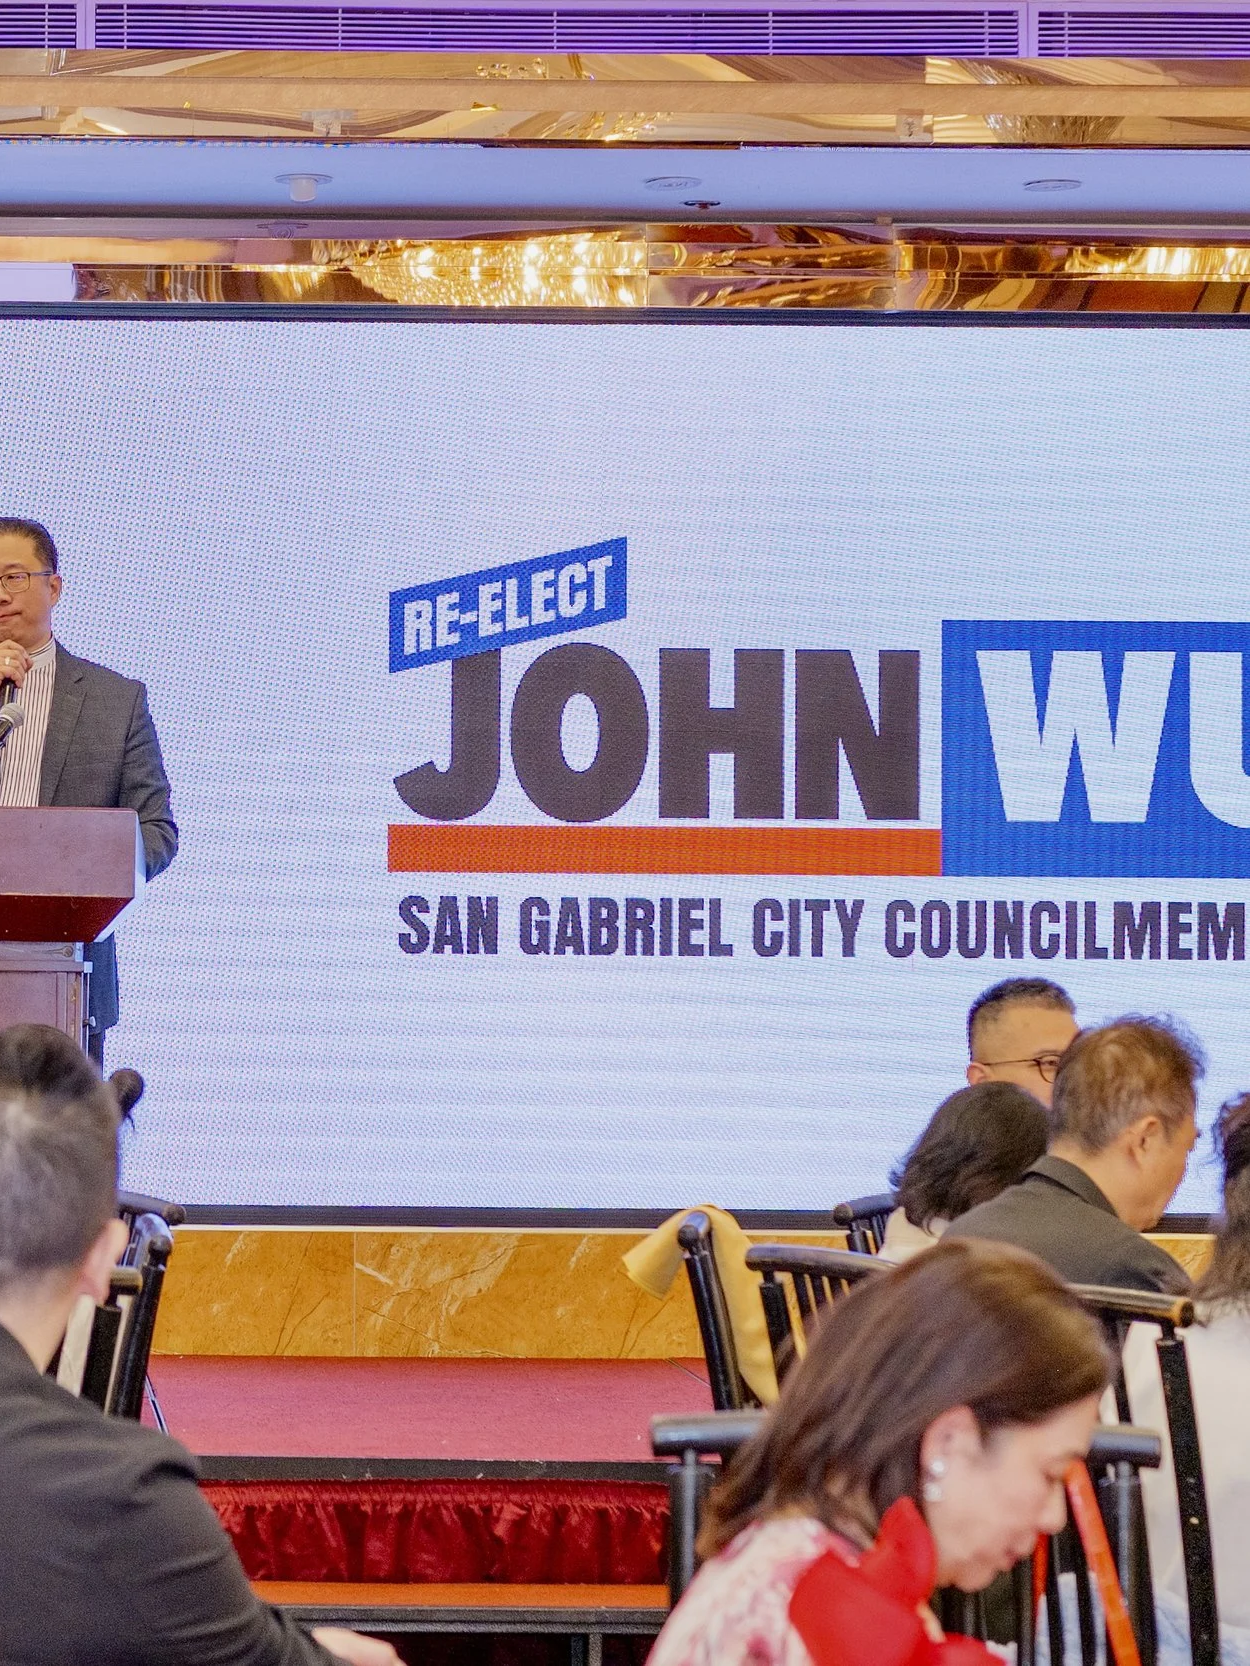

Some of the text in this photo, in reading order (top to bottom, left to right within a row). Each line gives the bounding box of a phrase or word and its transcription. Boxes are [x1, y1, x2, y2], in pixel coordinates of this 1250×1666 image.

[404, 555, 612, 655] RE-ELECT
[393, 643, 920, 822] JOHN
[398, 895, 1246, 961] SAN GABRIEL CITY COUNCILMEM
